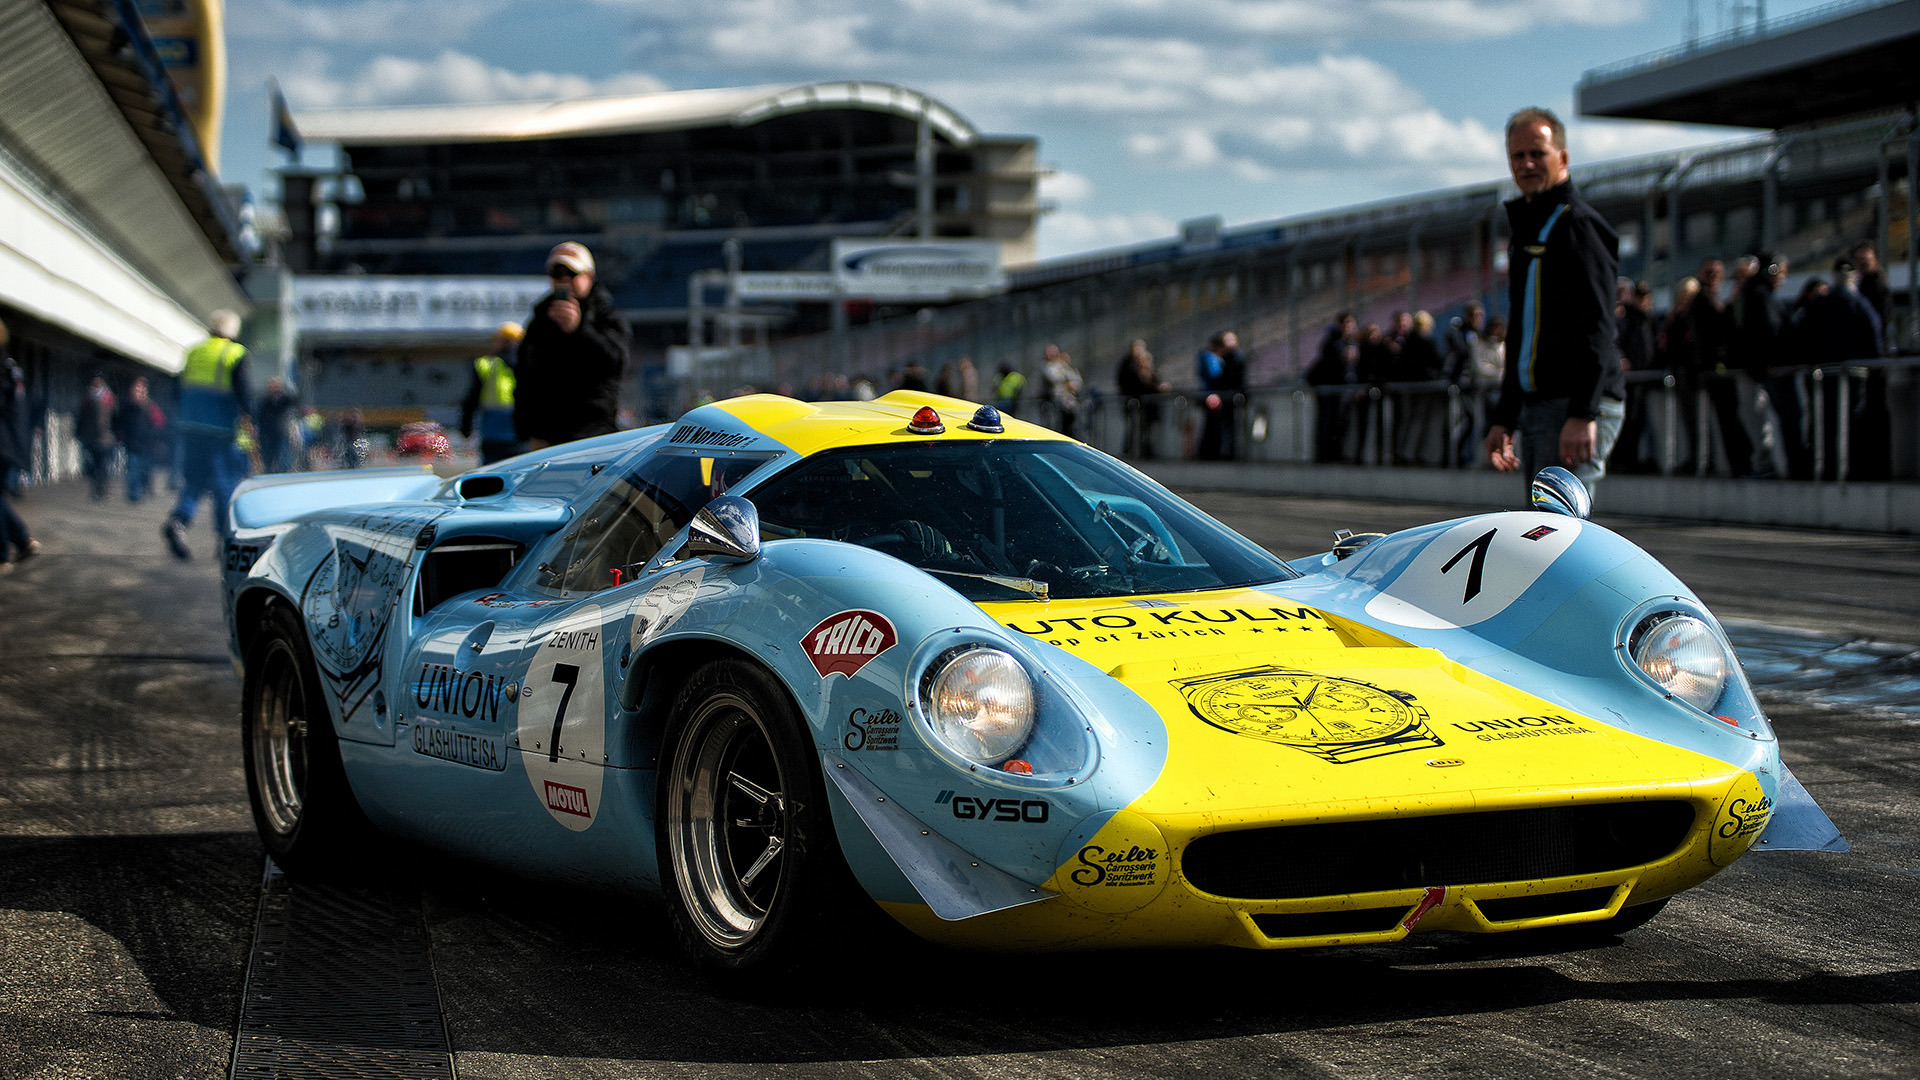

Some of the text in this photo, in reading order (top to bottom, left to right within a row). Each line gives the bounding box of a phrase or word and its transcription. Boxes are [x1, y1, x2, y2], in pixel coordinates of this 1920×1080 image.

[690, 427, 751, 447] Norinder
[1150, 607, 1322, 625] KULM
[547, 631, 599, 650] ZENITH
[813, 614, 885, 655] TRICO
[1095, 632, 1120, 643] of
[417, 663, 505, 723] UNION
[549, 662, 581, 763] 7
[1450, 715, 1576, 733] UNION
[845, 708, 903, 751] Seiler
[547, 785, 588, 815] MOTUL
[952, 796, 1049, 823] GYSO
[1071, 845, 1159, 887] Seiler
[1105, 861, 1156, 872] Carrosserie
[1105, 872, 1155, 883] Spritzwerk
